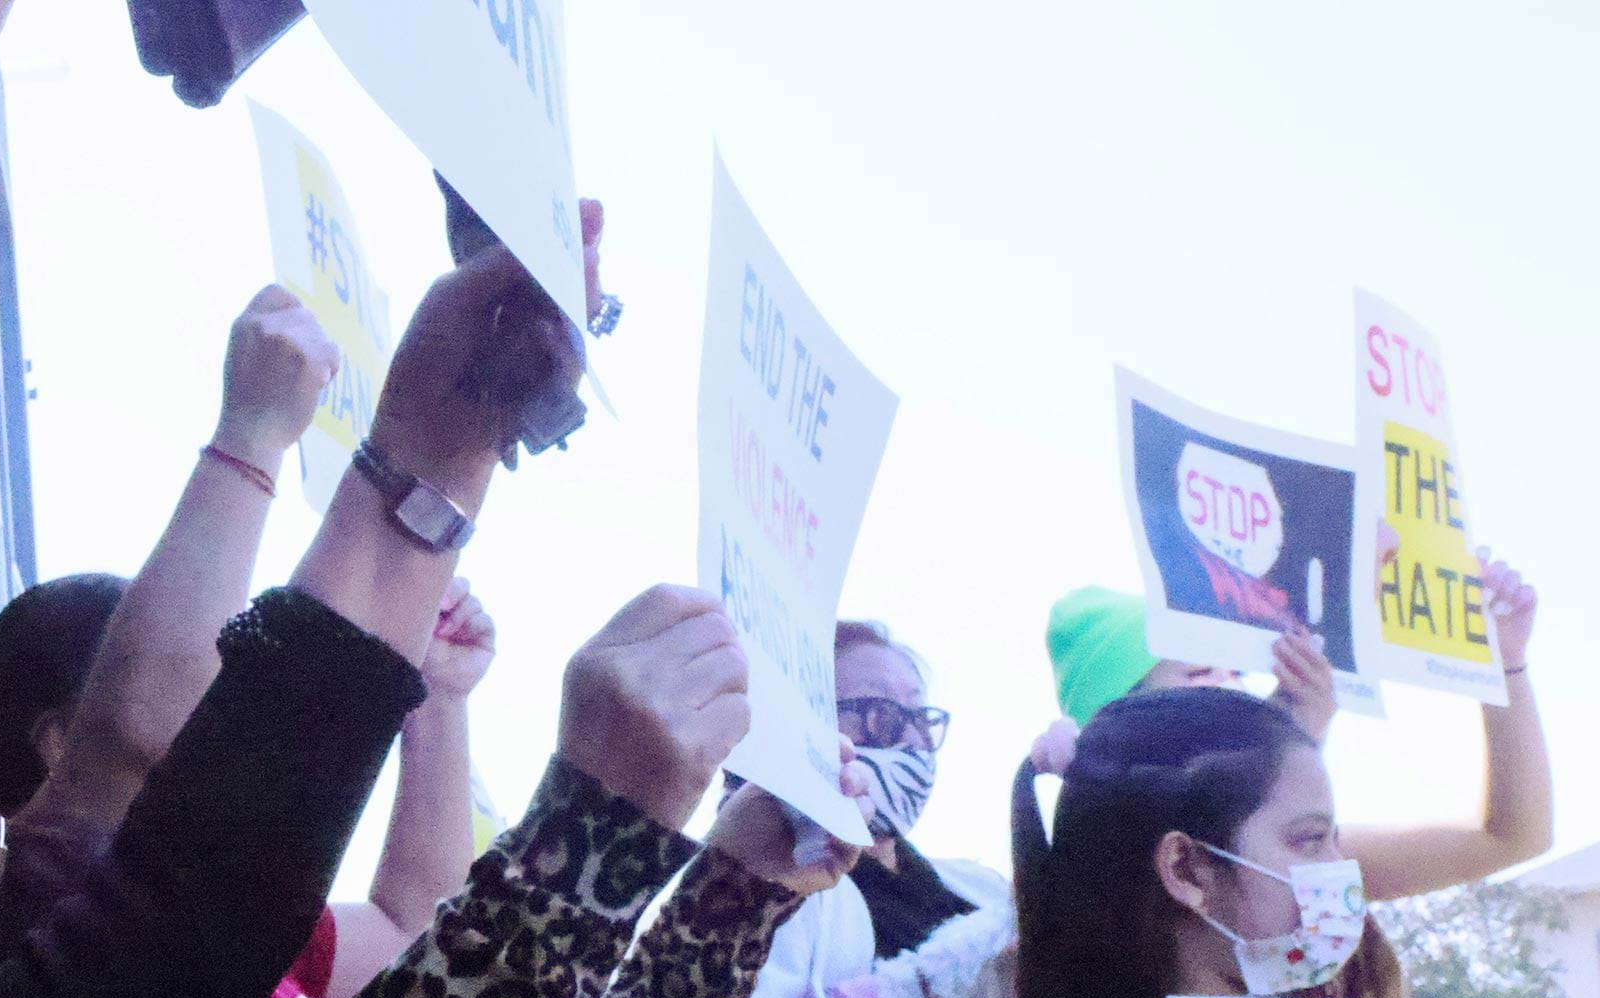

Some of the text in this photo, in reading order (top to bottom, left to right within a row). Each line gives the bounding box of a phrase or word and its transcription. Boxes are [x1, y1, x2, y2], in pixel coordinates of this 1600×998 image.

[738, 261, 836, 464] END THE
[1186, 469, 1272, 543] STOP
[1384, 442, 1464, 530] THE
[1378, 558, 1489, 648] HATE
